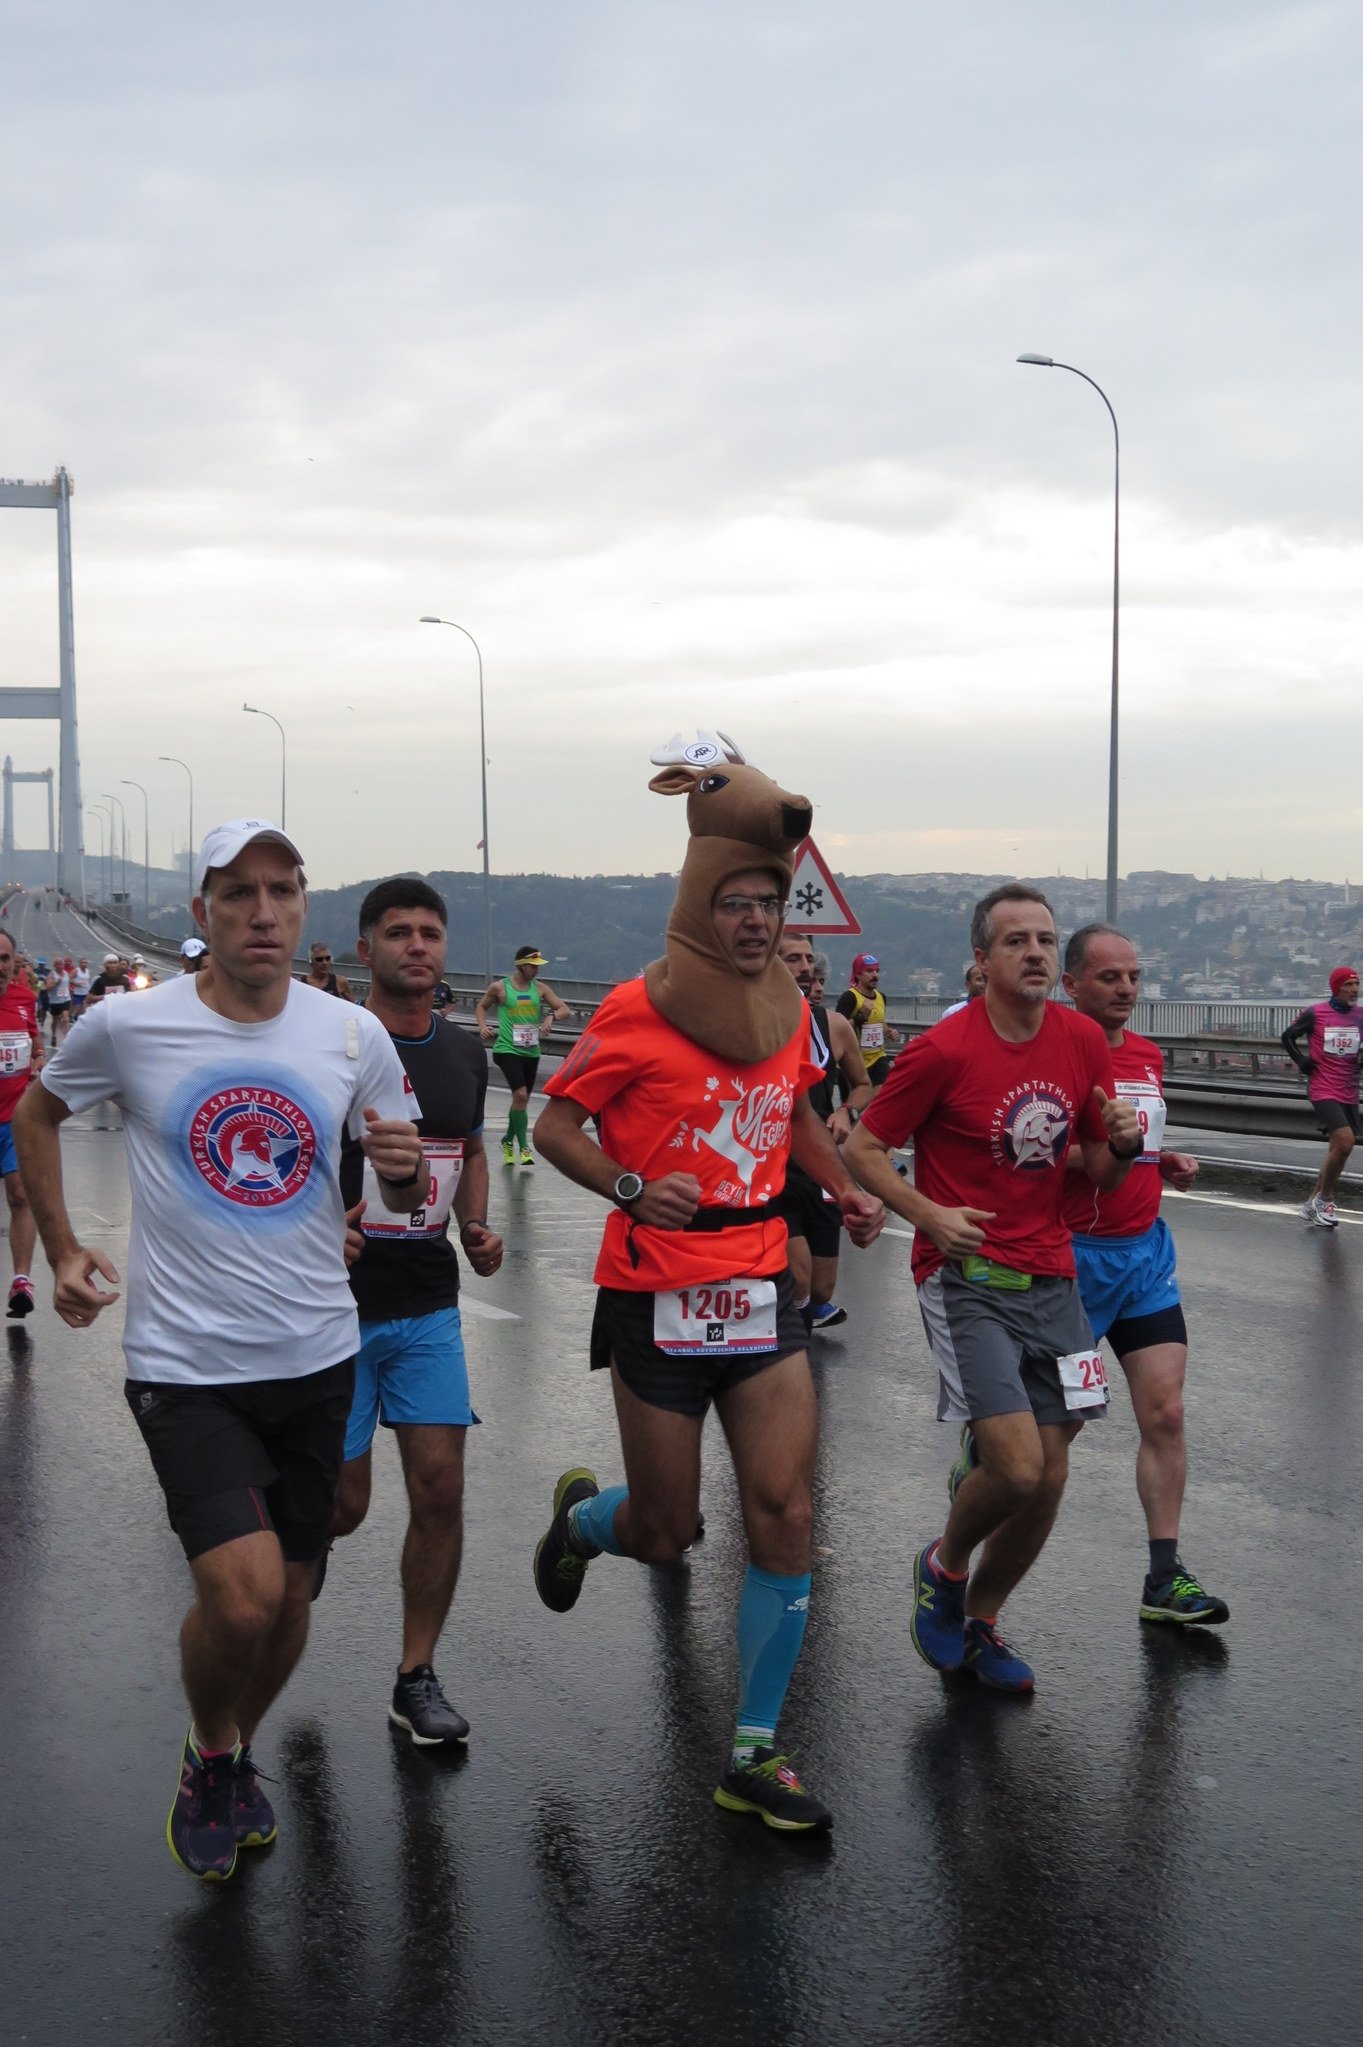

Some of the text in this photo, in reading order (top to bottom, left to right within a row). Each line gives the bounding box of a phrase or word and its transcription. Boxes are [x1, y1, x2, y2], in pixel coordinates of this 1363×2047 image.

[1332, 1038, 1352, 1048] 1362
[193, 1090, 314, 1183] TURKISH SPARTATHLON TEAM
[989, 1108, 1005, 1166] TURKISH
[678, 1289, 751, 1320] 1205
